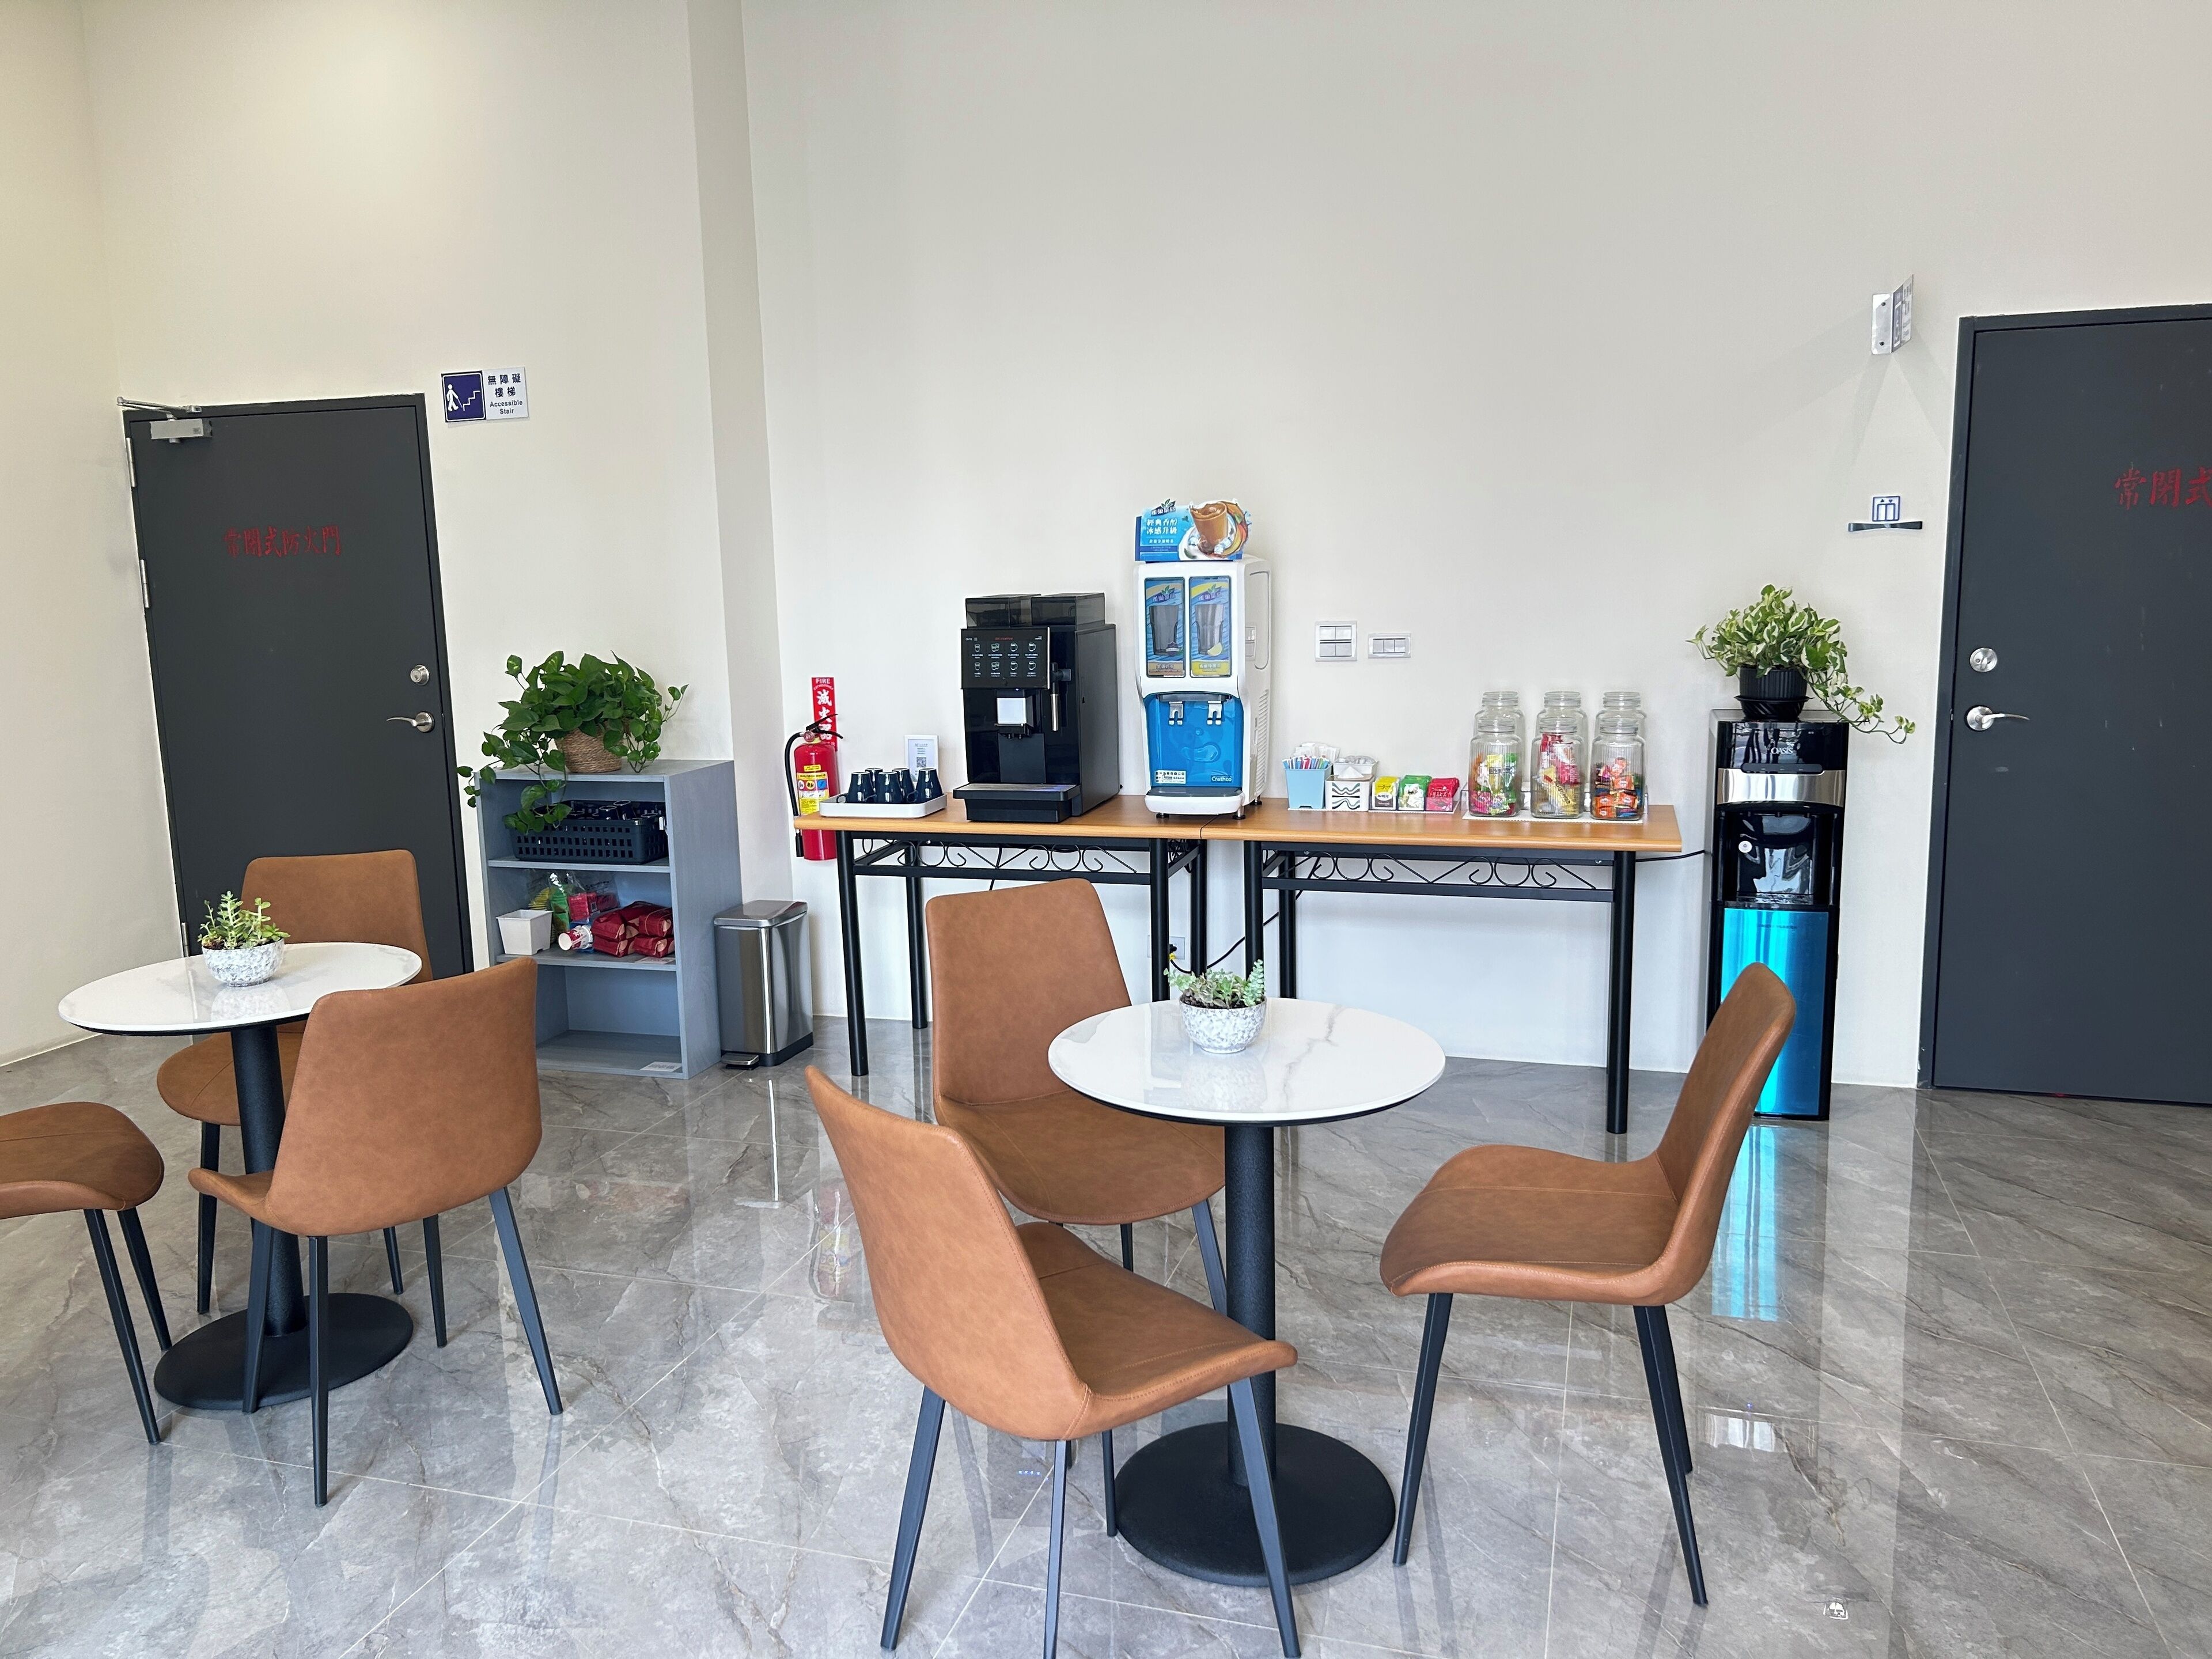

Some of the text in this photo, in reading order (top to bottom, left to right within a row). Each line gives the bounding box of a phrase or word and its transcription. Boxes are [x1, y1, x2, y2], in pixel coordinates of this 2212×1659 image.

[487, 373, 521, 385] 無障礙
[495, 387, 516, 397] 樓梯
[490, 399, 523, 407] Accessible
[816, 689, 833, 740] 滅火器
